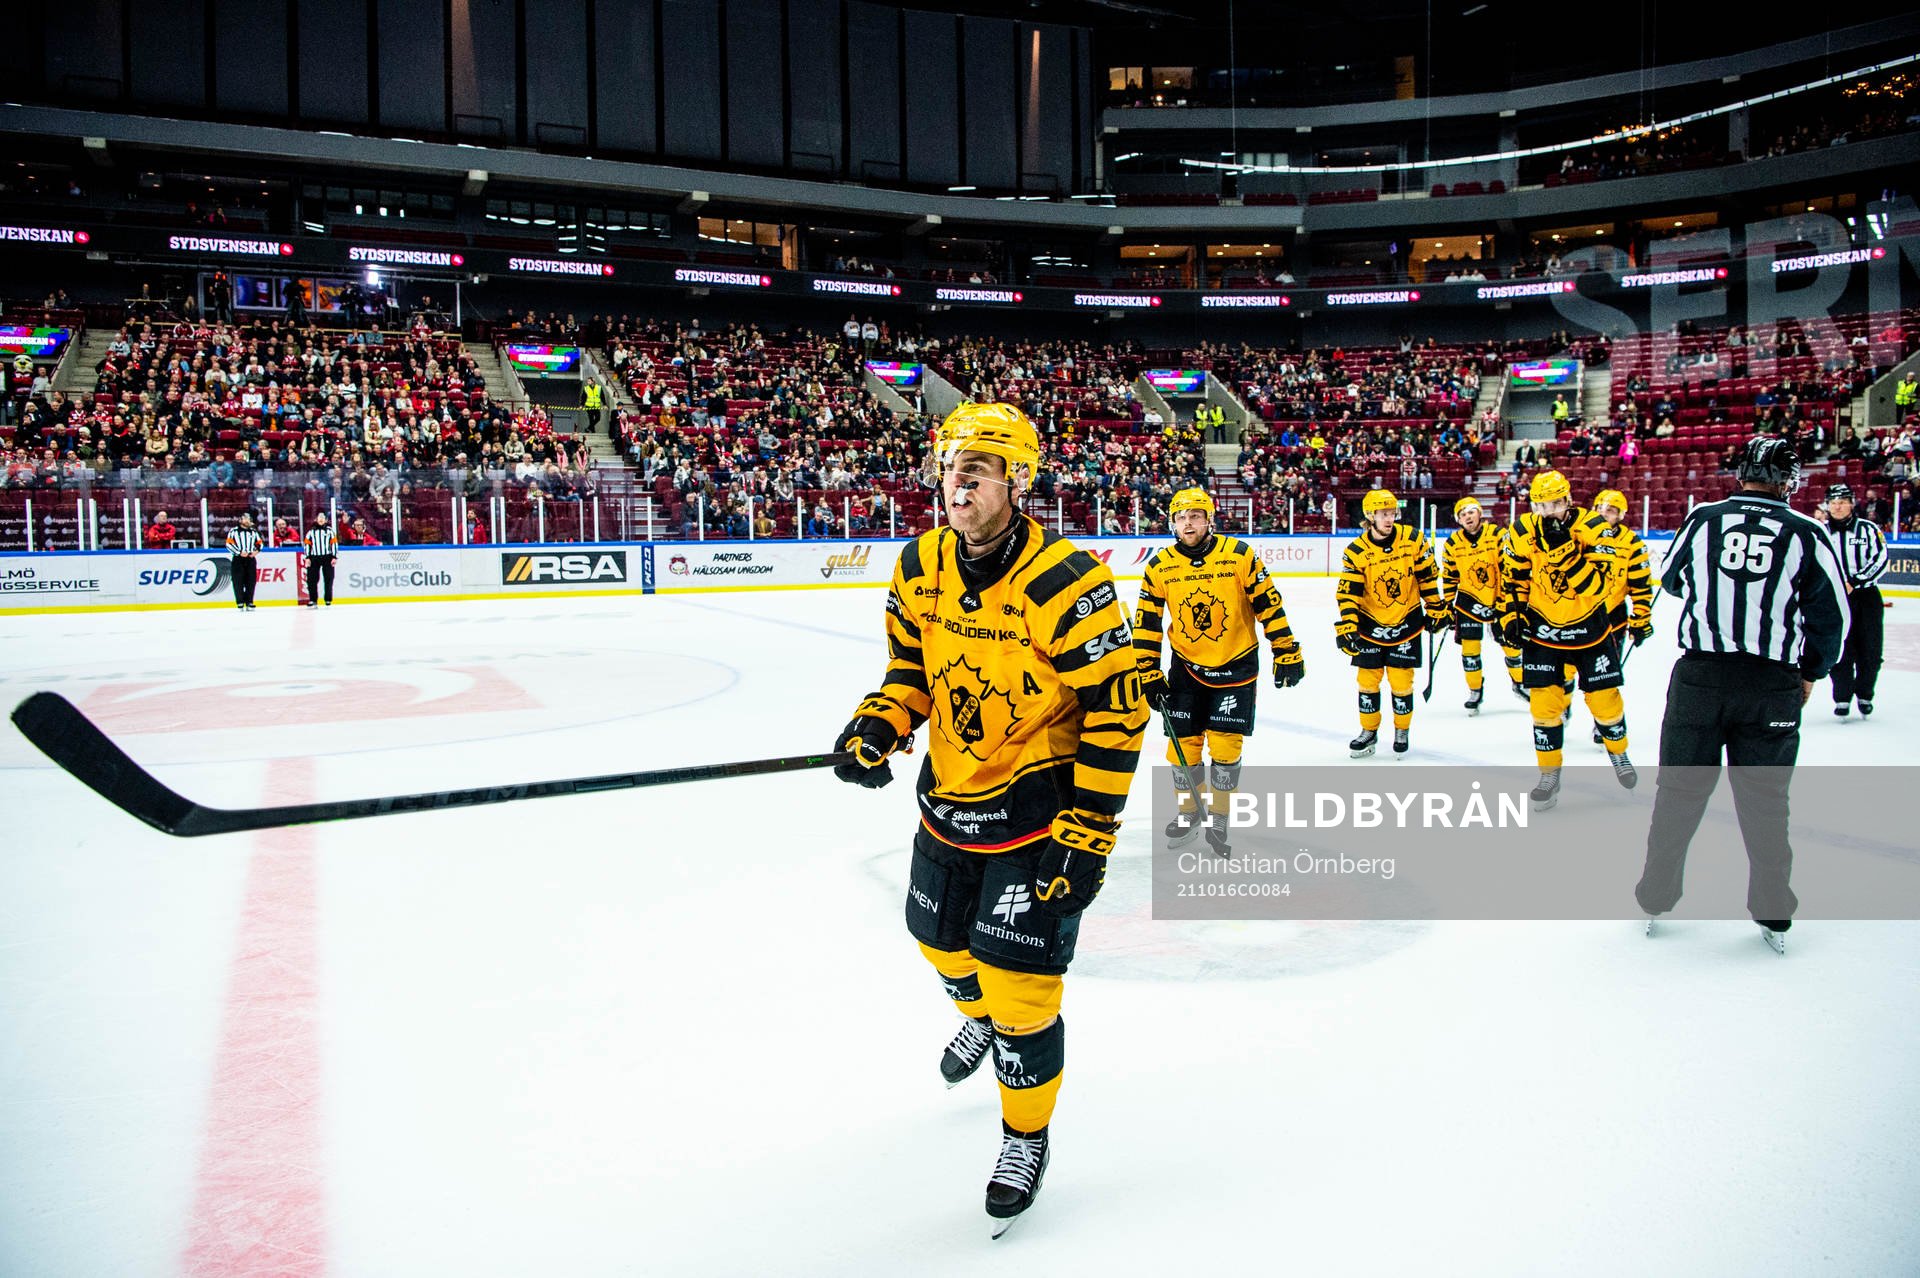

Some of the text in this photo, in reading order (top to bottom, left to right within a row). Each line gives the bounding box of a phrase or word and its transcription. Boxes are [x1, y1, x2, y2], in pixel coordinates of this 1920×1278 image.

[170, 236, 280, 255] SYDSVENSKAN
[349, 247, 451, 265] SYDSVENSKAN
[1771, 248, 1873, 273] SYDSVENSKAN
[509, 258, 603, 275] SYDSVENSKAN
[675, 269, 761, 285] SYDSVENSKAN
[1621, 268, 1716, 287] SYDSVENSKAN
[813, 279, 892, 296] SYDSVENSKAN
[936, 288, 1014, 302] SYDSVENSKAN
[1477, 281, 1564, 299] SYDSVENSKAN
[1074, 294, 1151, 307] SYDSVENSKAN
[1201, 296, 1280, 307] SYDSVENSKAN
[1327, 291, 1409, 305] SYDSVENSKAN
[1740, 505, 1772, 514] CCM
[1849, 538, 1868, 546] SHL
[712, 553, 753, 563] PARTNERS
[825, 545, 872, 570] guld
[1256, 545, 1314, 563] igator
[1720, 531, 1776, 574] 85
[531, 555, 625, 581] RSA
[693, 564, 774, 576] HÄLSOSAM UNGDOM
[138, 570, 209, 586] SUPER
[348, 570, 453, 592] SportsClub
[1536, 625, 1561, 642] SK
[1022, 671, 1043, 696] A
[1109, 670, 1141, 711] 10
[951, 809, 1008, 822] Skellefteå
[975, 920, 1047, 949] martinsons
